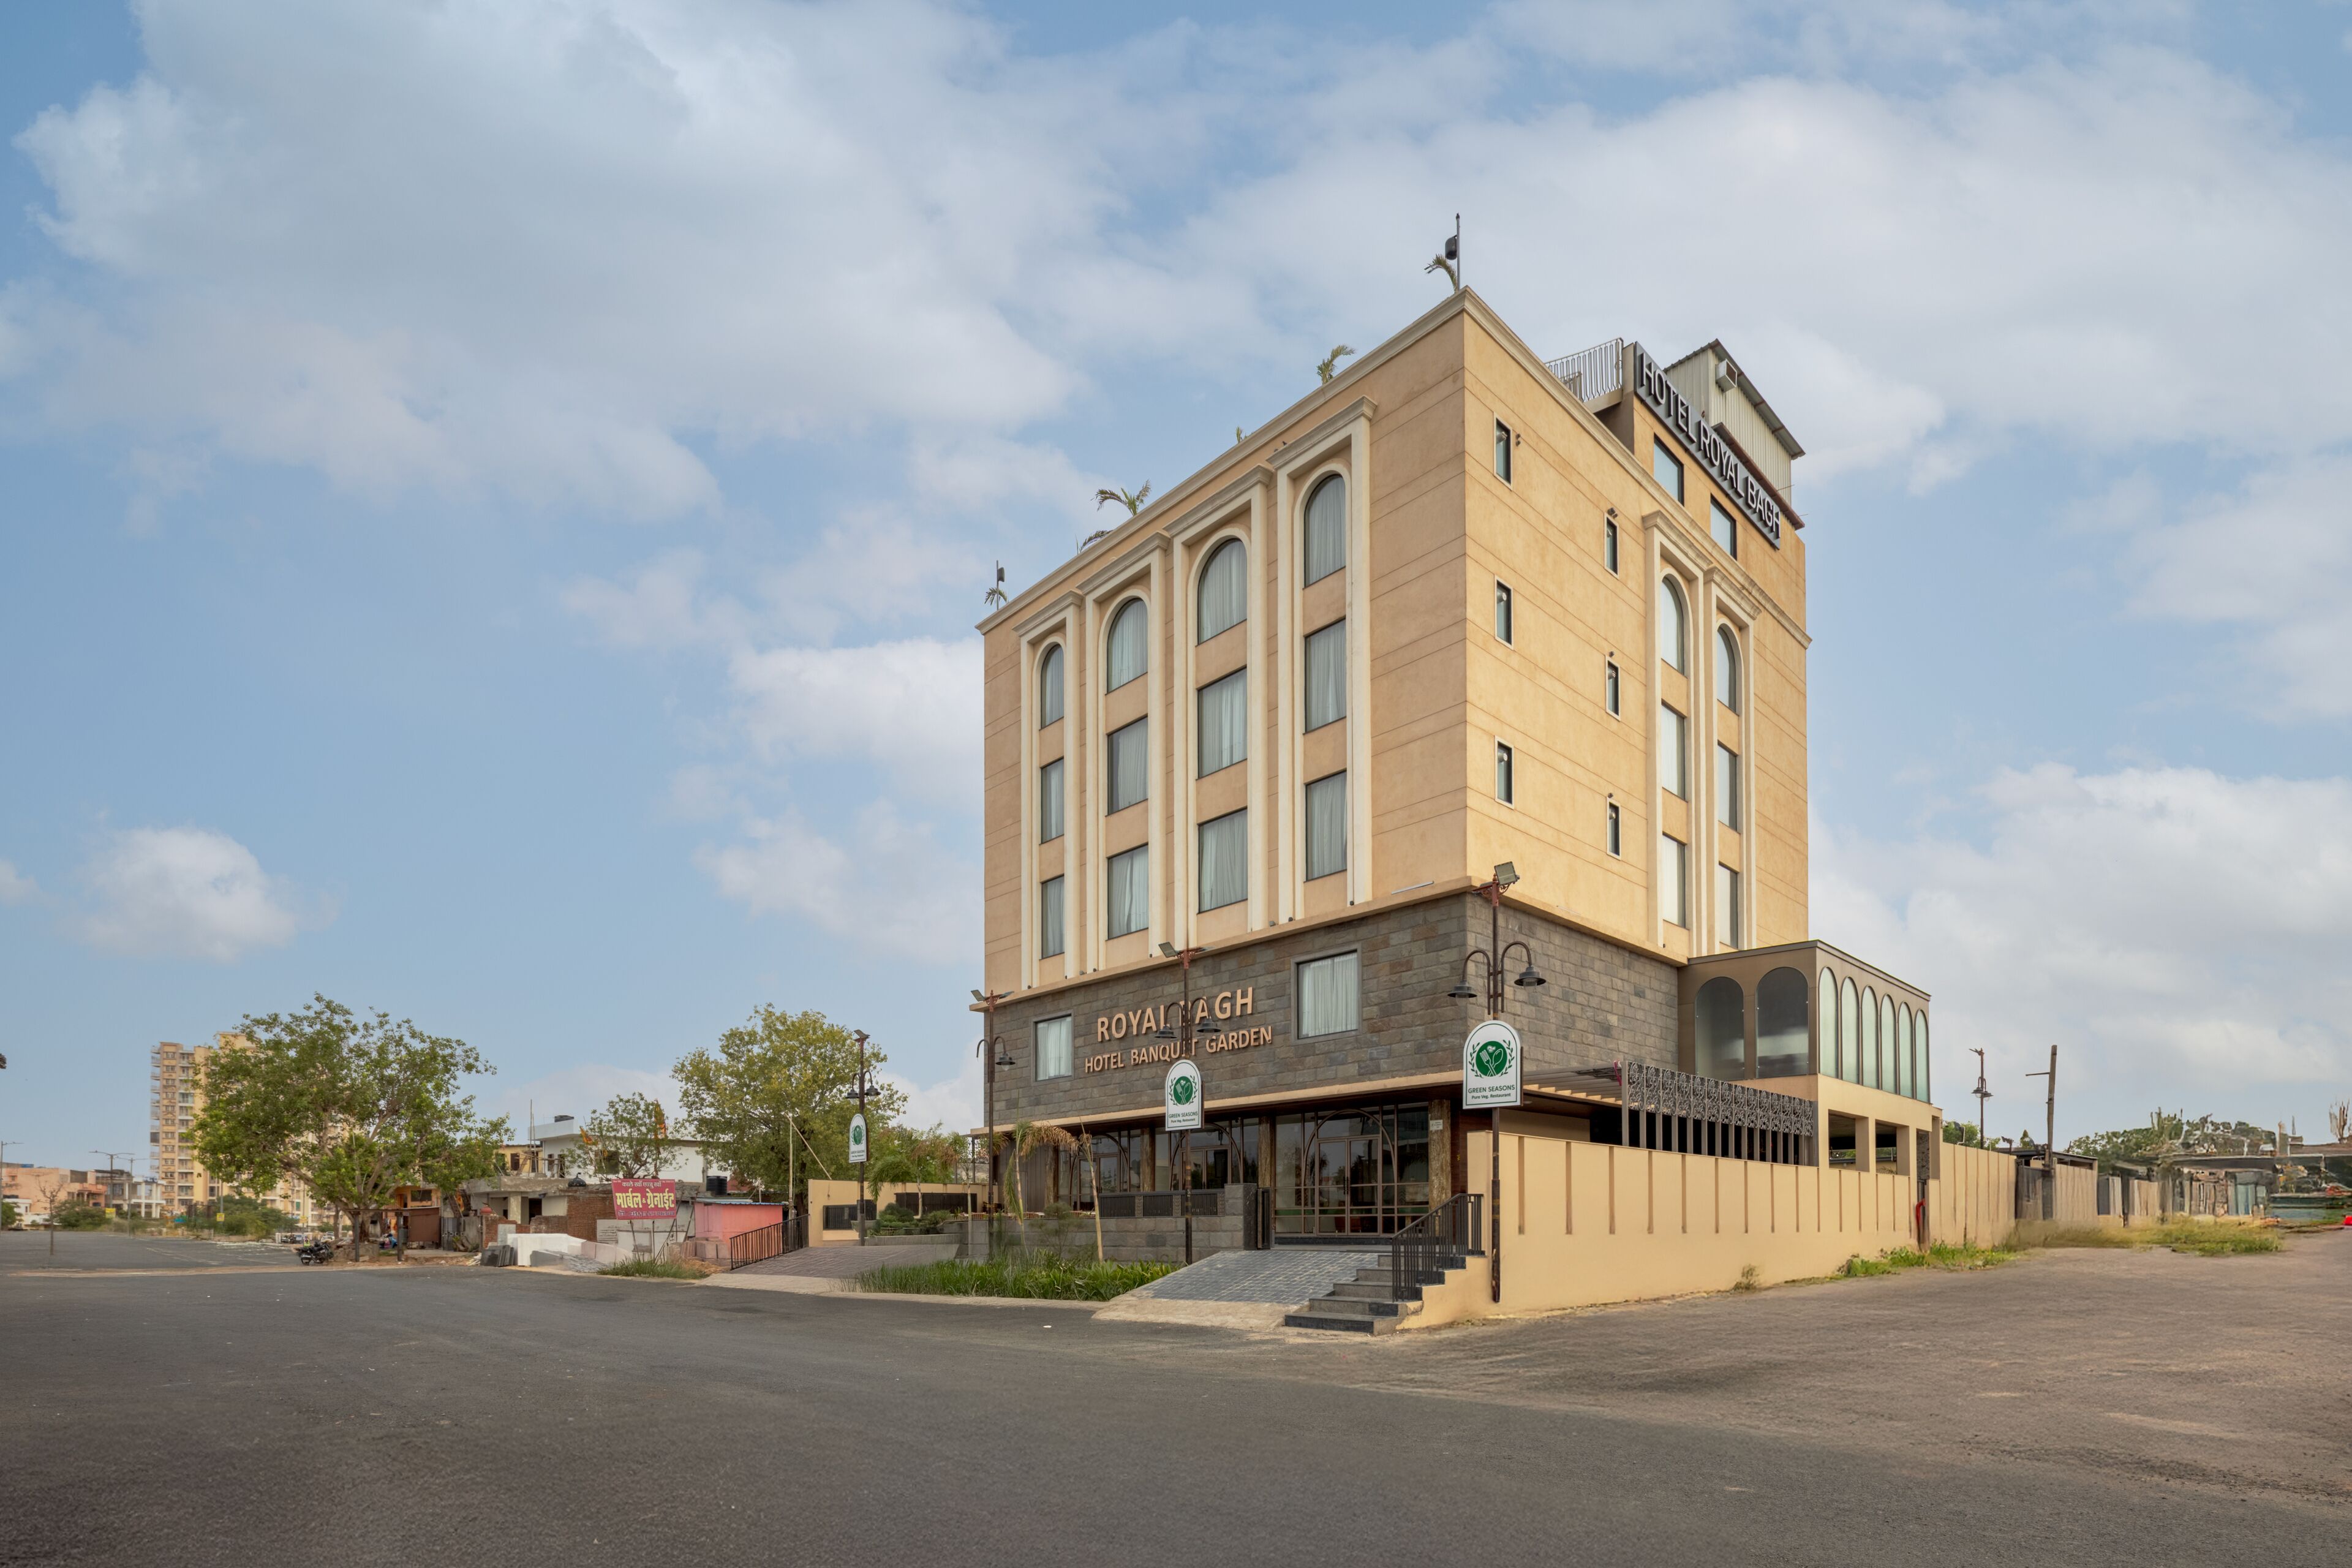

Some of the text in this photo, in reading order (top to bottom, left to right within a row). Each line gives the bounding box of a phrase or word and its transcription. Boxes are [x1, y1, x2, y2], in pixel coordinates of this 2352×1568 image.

[1641, 352, 1781, 539] HOTEL ROYAL BAGH
[1098, 1005, 1170, 1042] ROYAL
[1085, 1025, 1272, 1073] HOTEL BANQUT GARDEN
[615, 1188, 643, 1208] मार्बल
[646, 1188, 675, 1210] ग्रेनाईट
